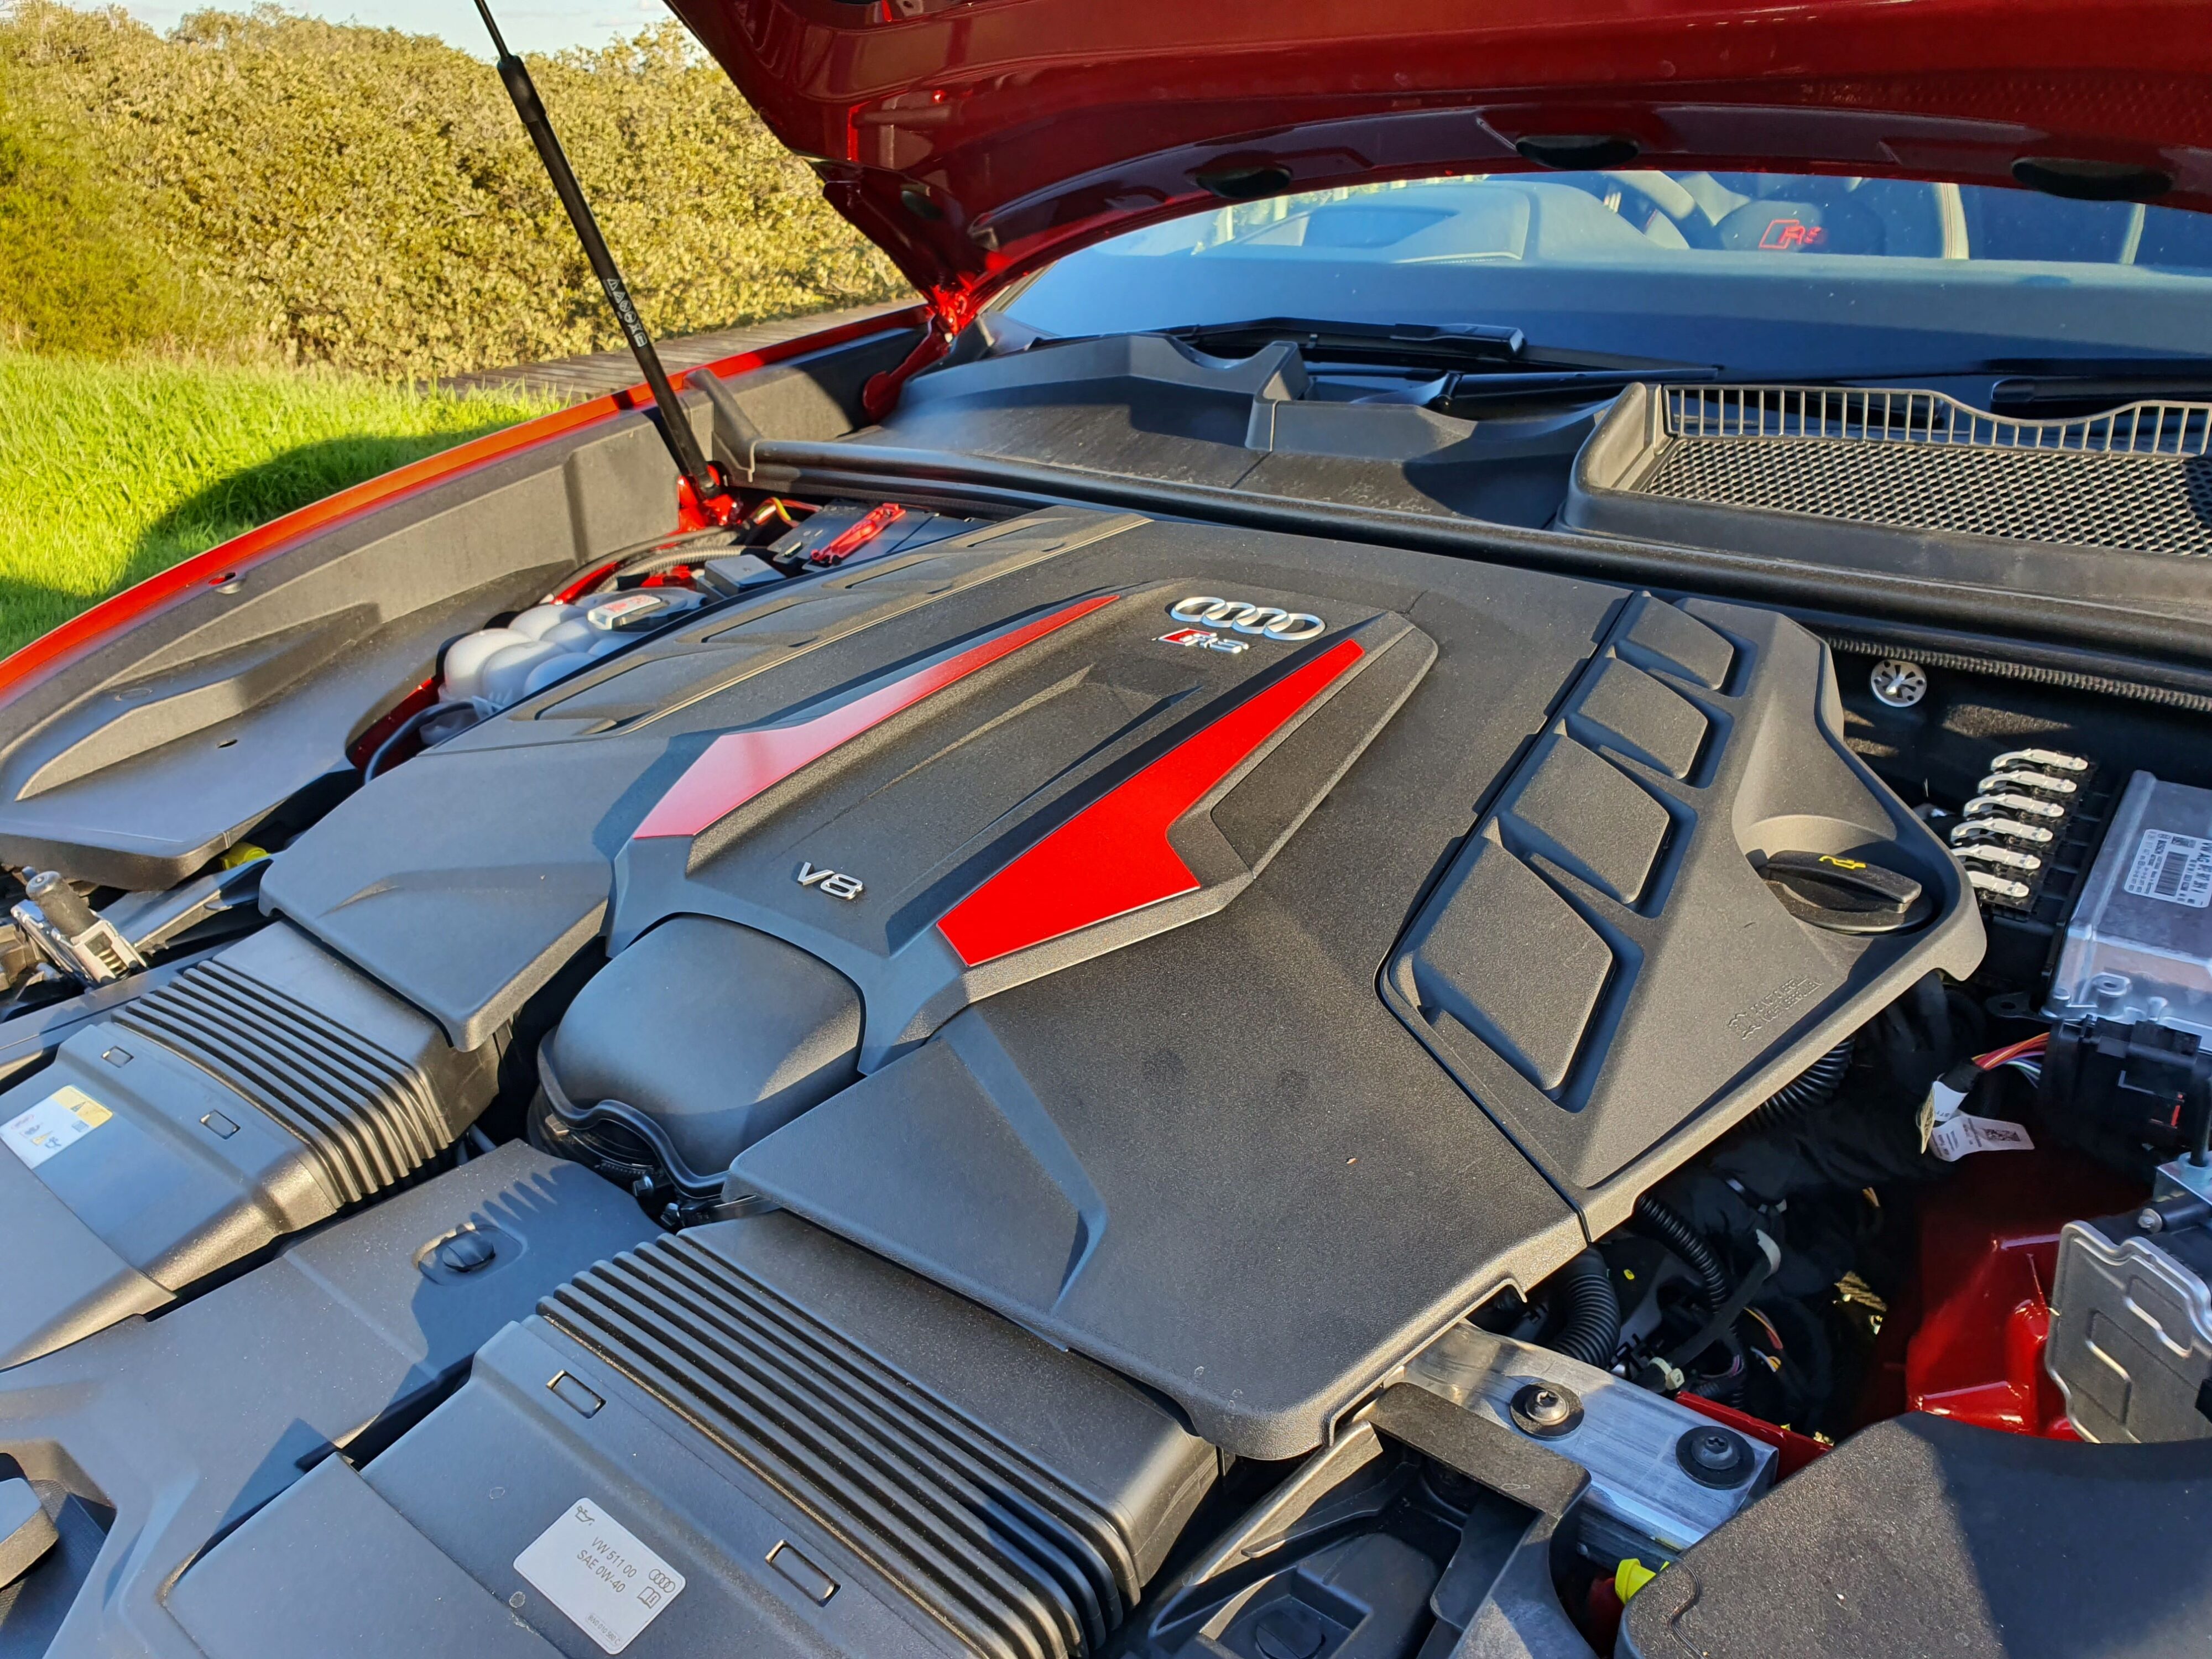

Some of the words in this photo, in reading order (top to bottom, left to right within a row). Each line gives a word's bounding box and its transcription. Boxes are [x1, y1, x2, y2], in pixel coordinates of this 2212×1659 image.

[797, 861, 864, 900] V8
[577, 1550, 599, 1570] SAE
[596, 1566, 625, 1593] 0W-40
[591, 1537, 611, 1554] VW
[606, 1551, 625, 1568] 511
[623, 1564, 637, 1578] 00
